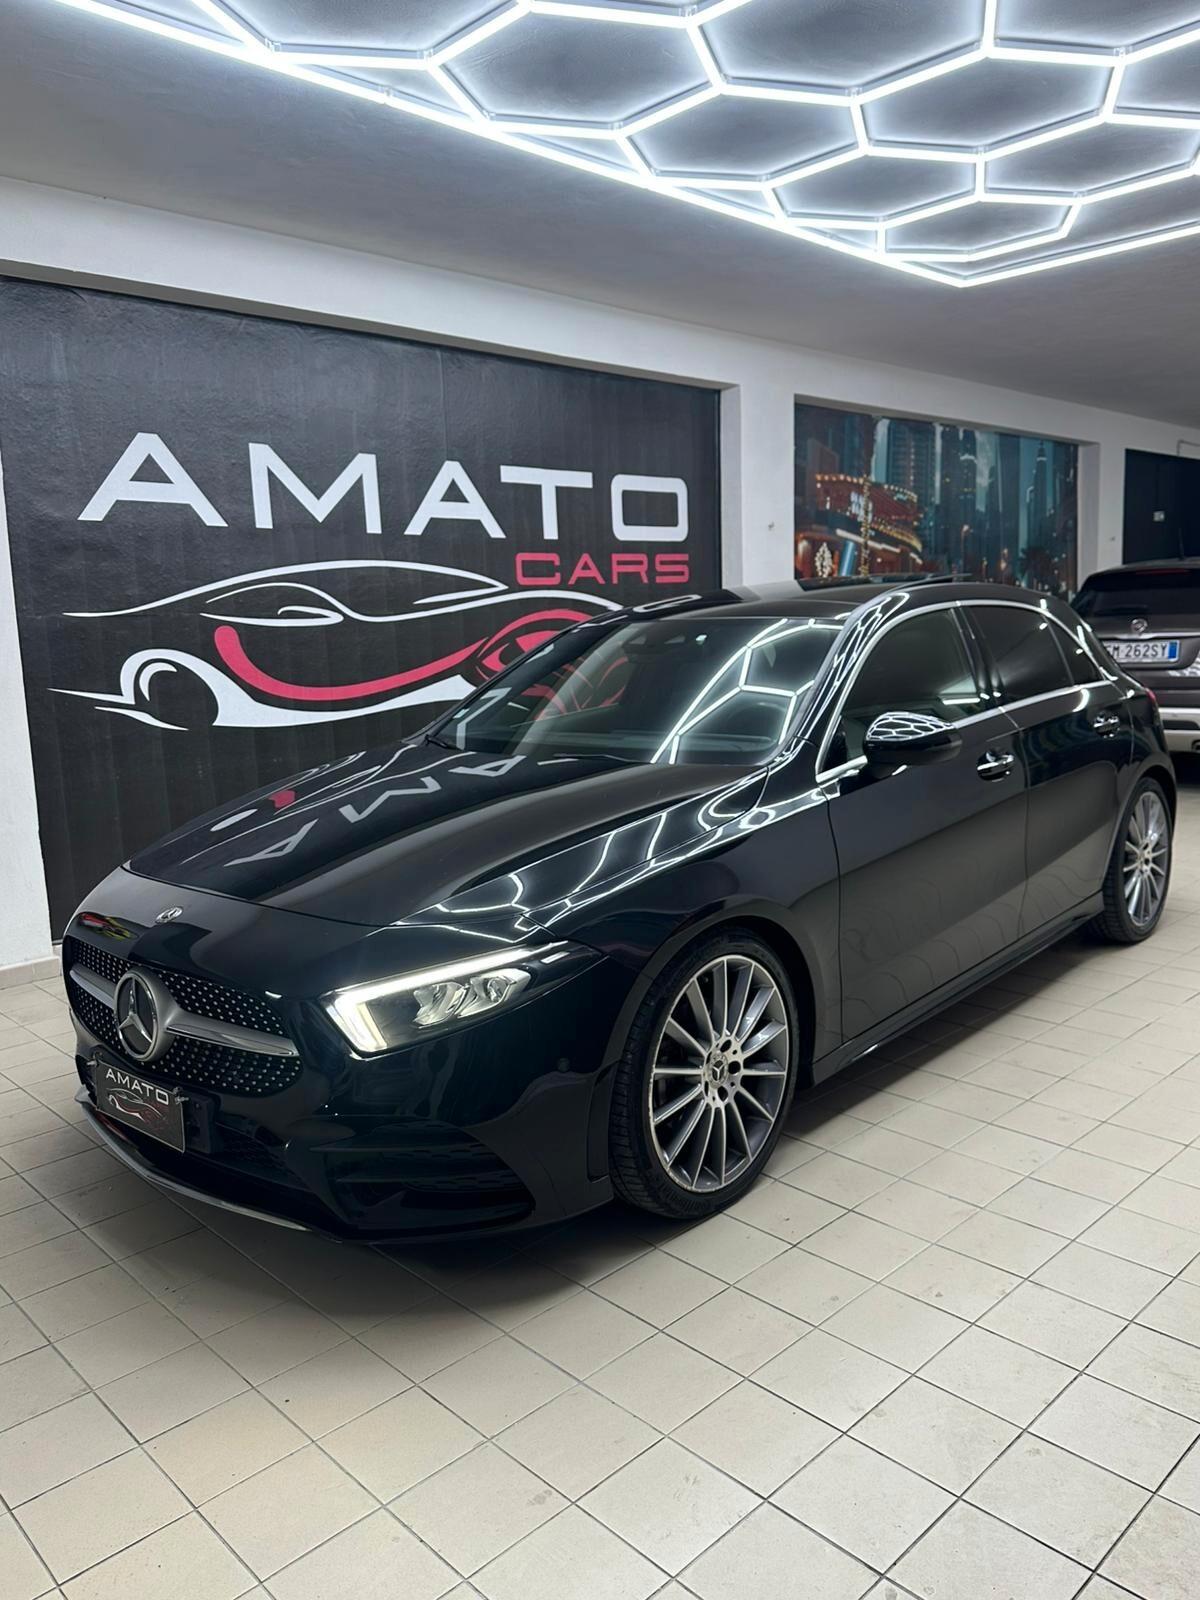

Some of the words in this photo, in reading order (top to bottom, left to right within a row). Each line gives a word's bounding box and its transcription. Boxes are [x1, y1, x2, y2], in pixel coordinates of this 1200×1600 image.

[78, 432, 690, 542] AMATO
[515, 552, 690, 587] CARS
[106, 1068, 169, 1106] AMATO
